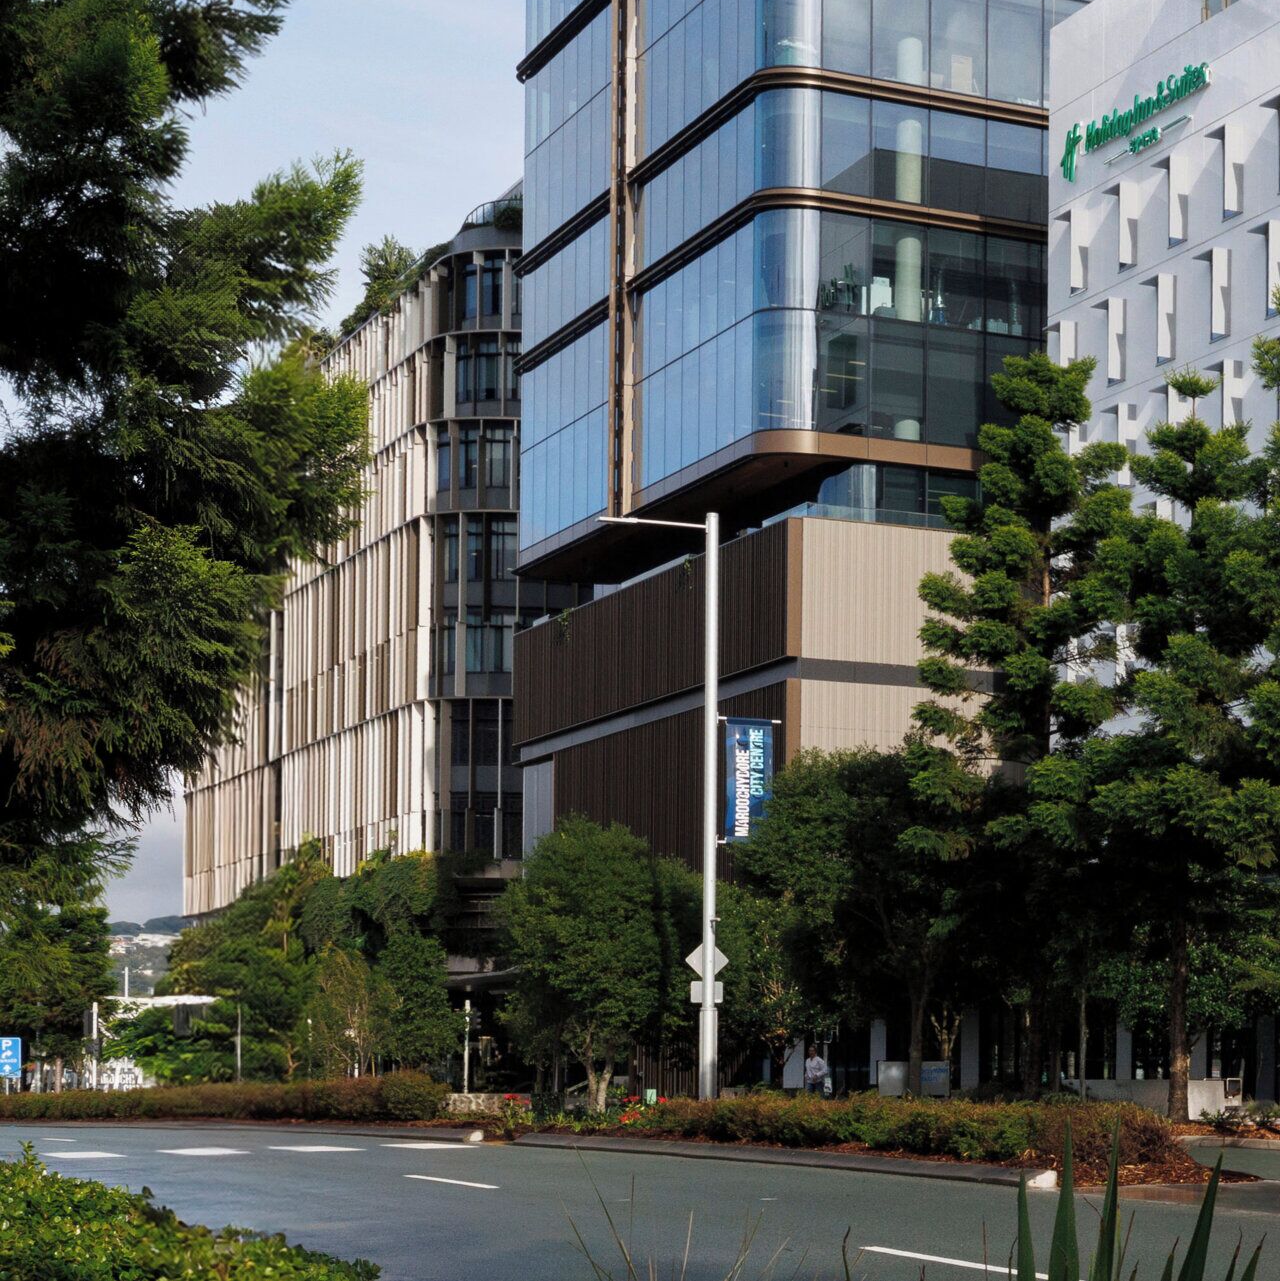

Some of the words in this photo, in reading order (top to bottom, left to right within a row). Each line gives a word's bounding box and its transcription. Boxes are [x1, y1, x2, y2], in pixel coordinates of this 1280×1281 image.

[749, 728, 764, 770] CENTRE
[735, 749, 750, 837] MAROOCHYDORE
[750, 771, 764, 797] CITY
